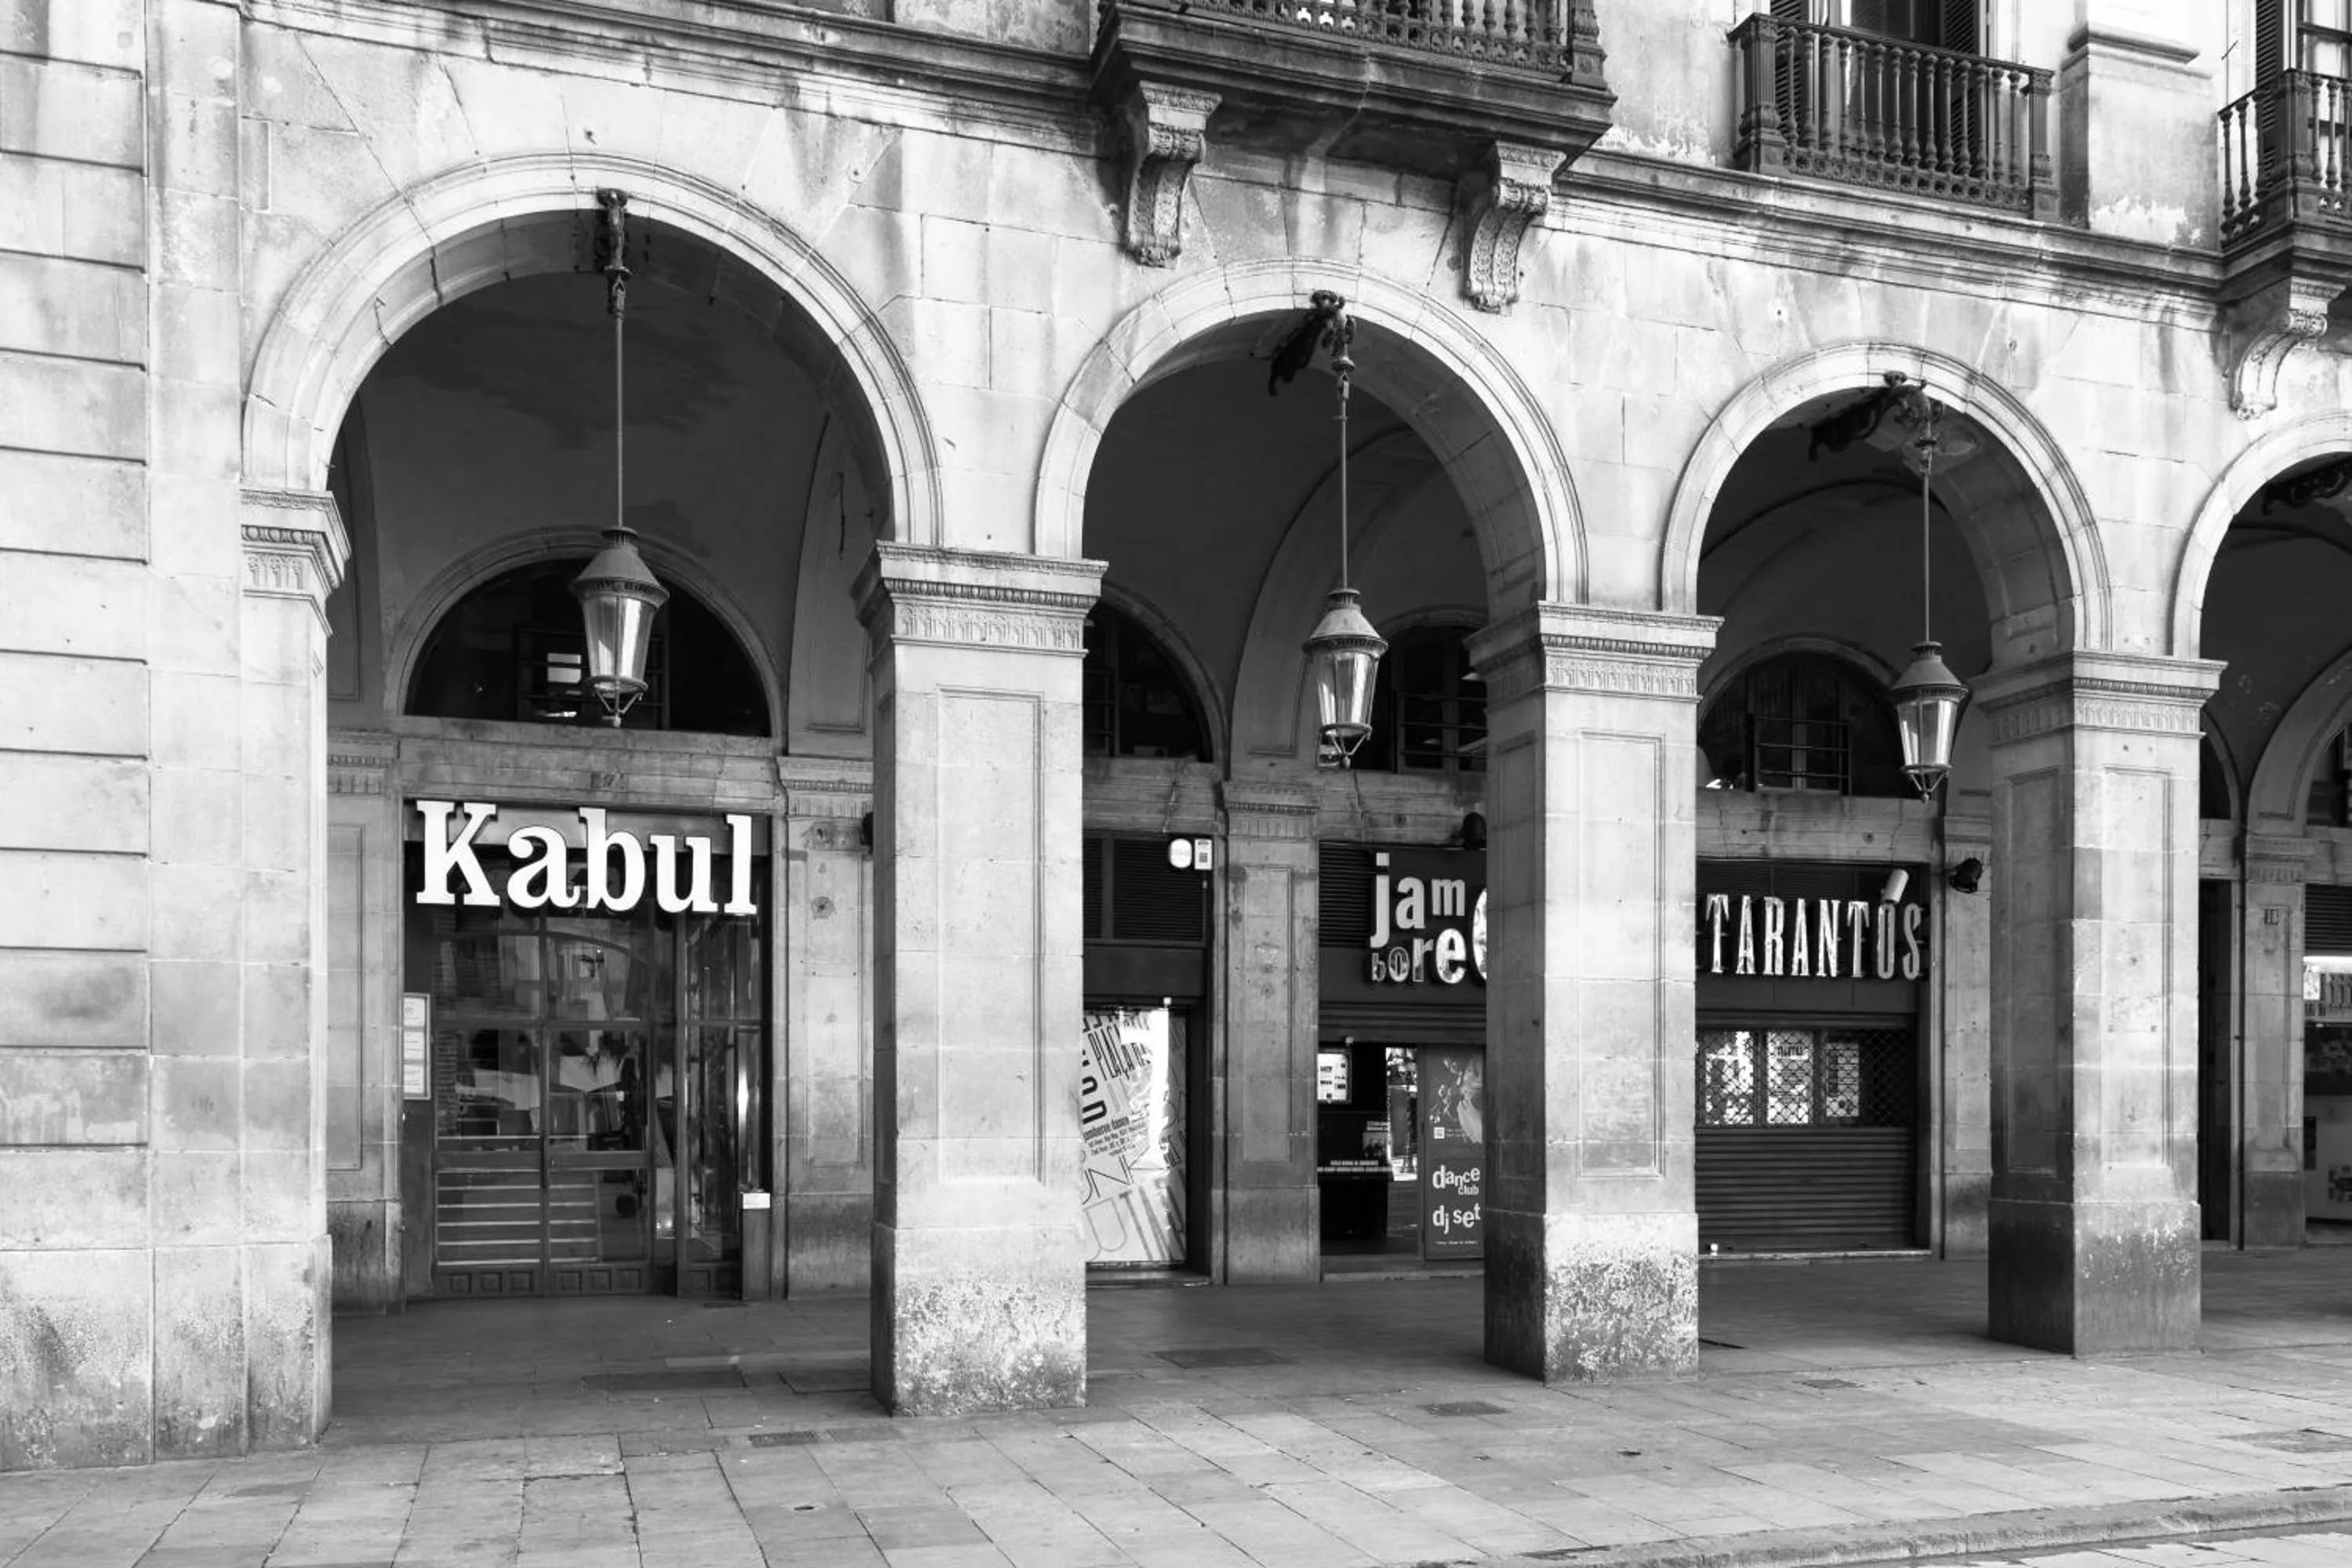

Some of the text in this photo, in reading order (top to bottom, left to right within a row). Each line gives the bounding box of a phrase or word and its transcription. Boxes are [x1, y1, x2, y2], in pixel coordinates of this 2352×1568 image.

[416, 800, 757, 915] Kabul
[1370, 852, 1466, 948] jam
[1705, 893, 1921, 980] TARANTOS
[1432, 1164, 1481, 1189] dance
[1457, 1185, 1479, 1196] club
[1432, 1202, 1481, 1235] dj set
